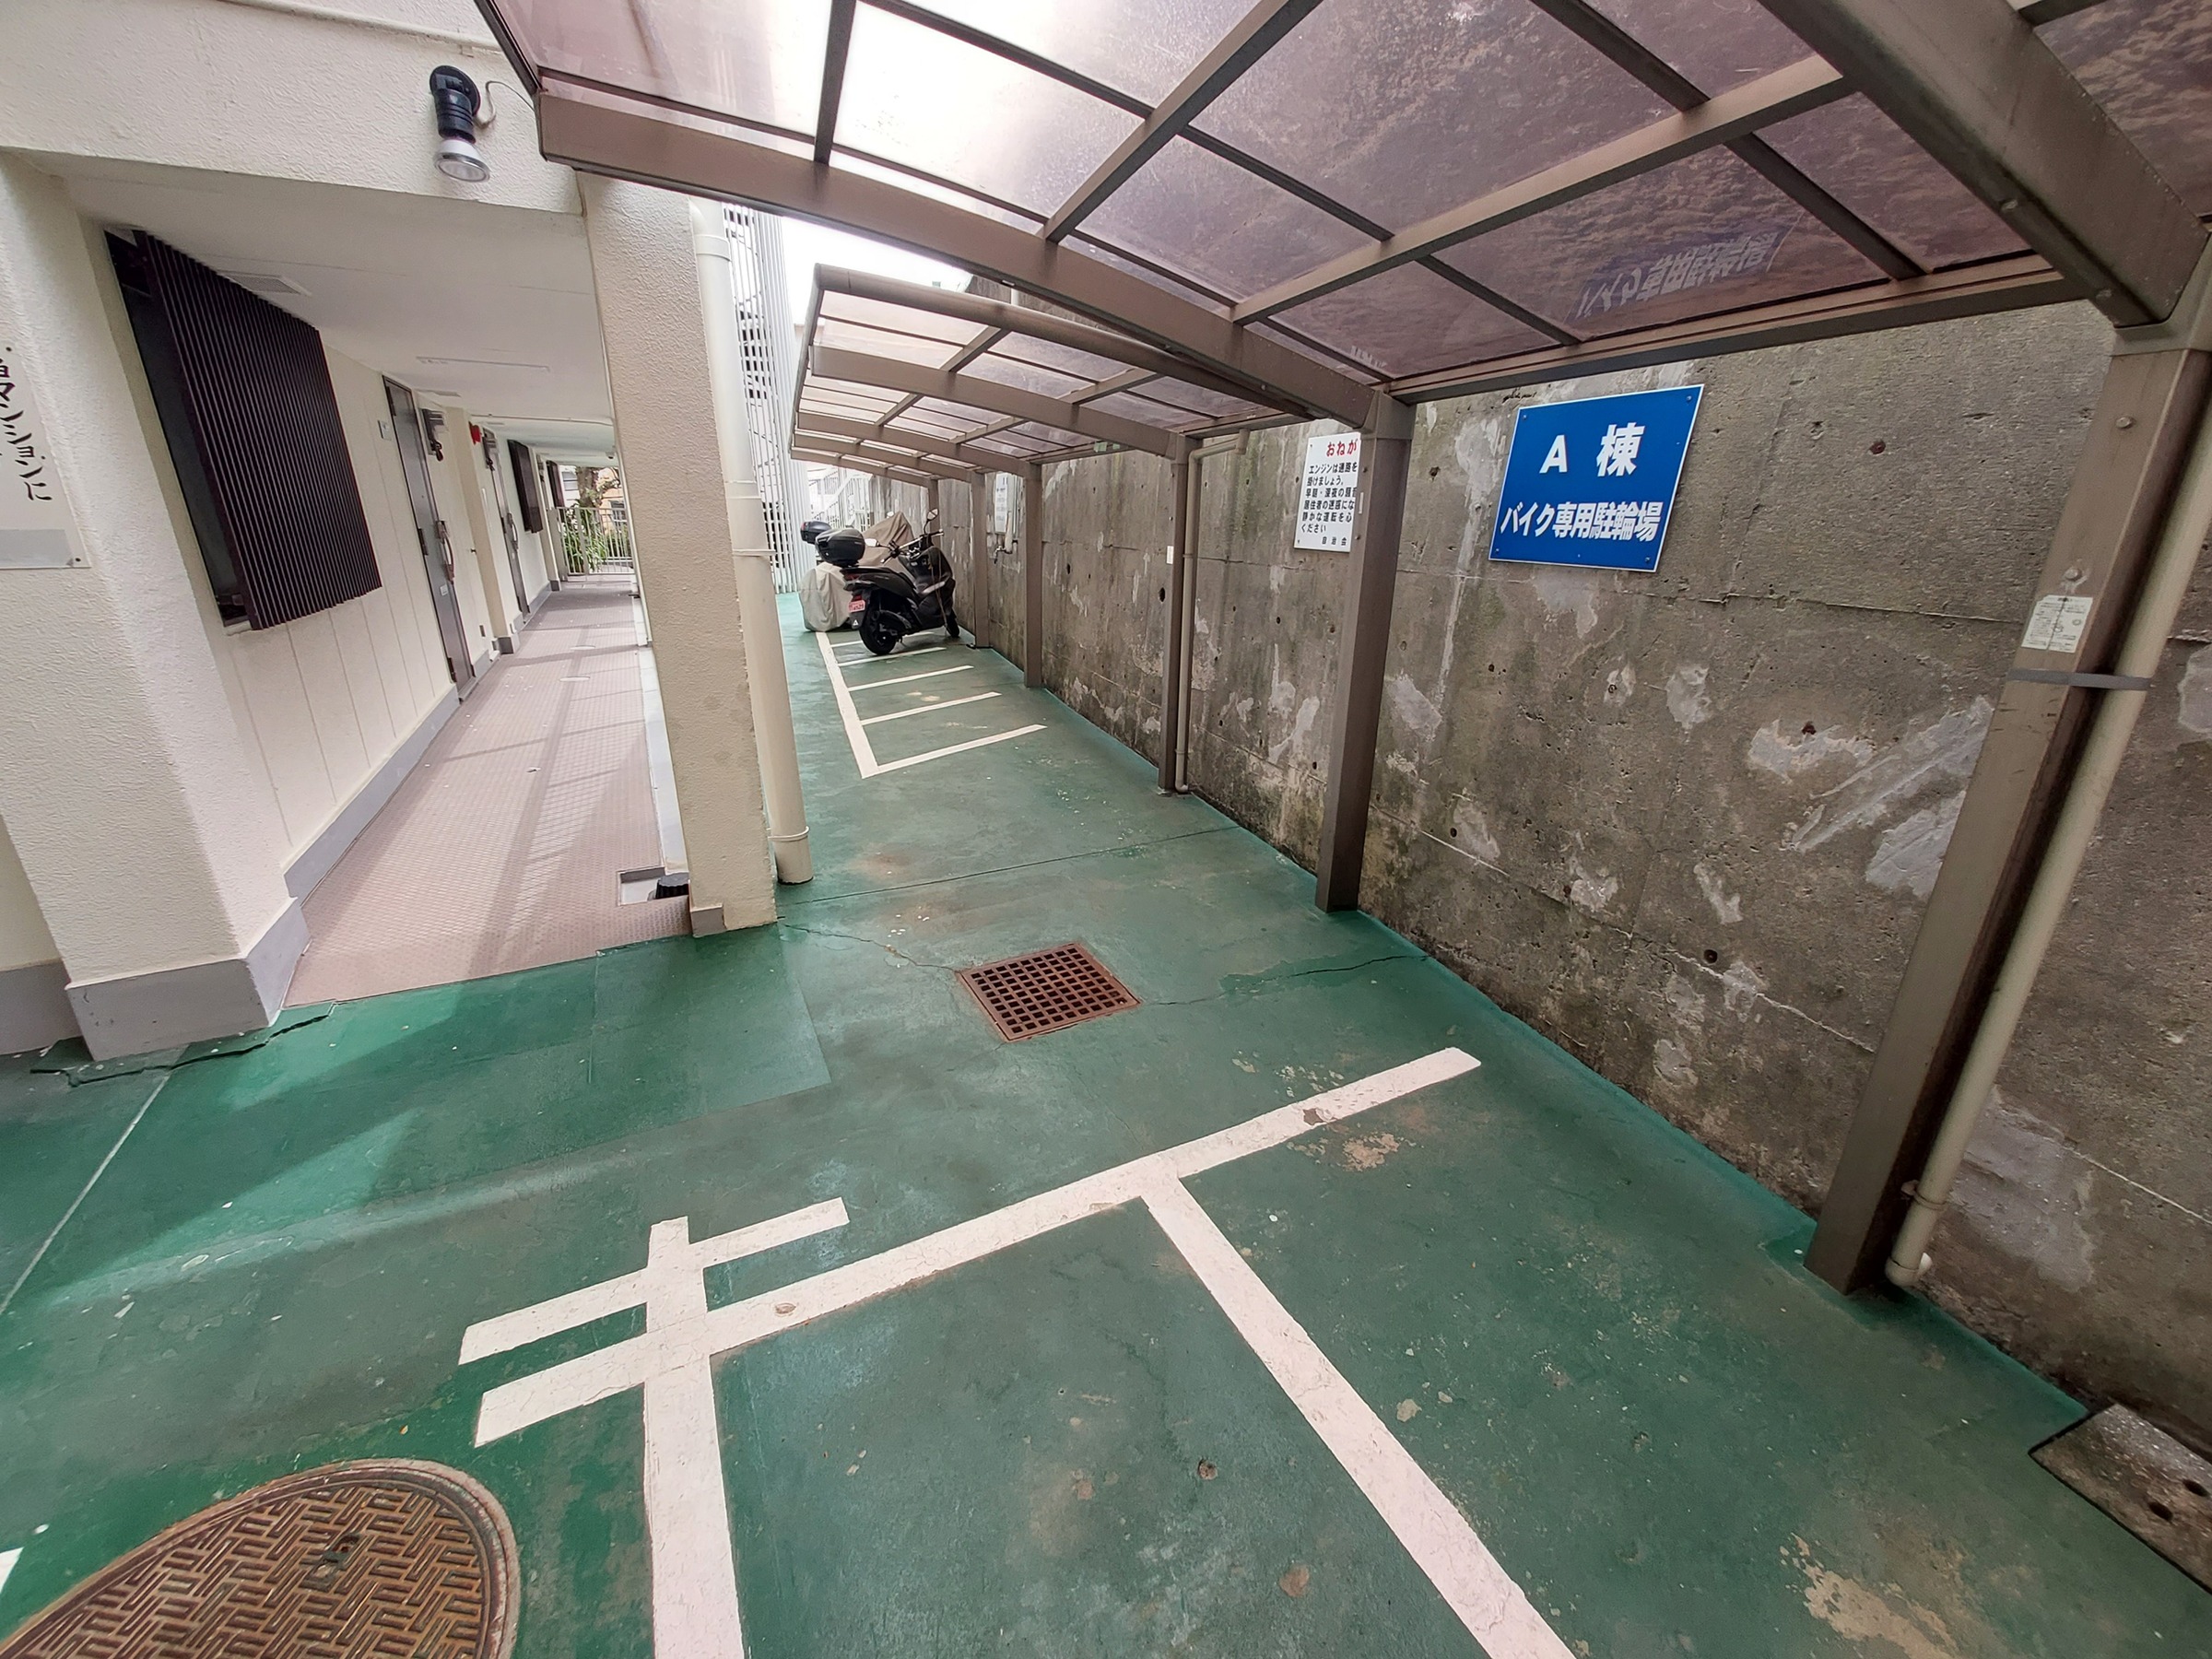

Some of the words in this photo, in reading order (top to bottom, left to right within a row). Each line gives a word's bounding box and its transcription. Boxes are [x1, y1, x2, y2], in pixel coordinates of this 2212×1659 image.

[1326, 439, 1358, 456] おねが
[1301, 524, 1326, 533] ください
[1500, 500, 1663, 541] バイク専用駐輪場
